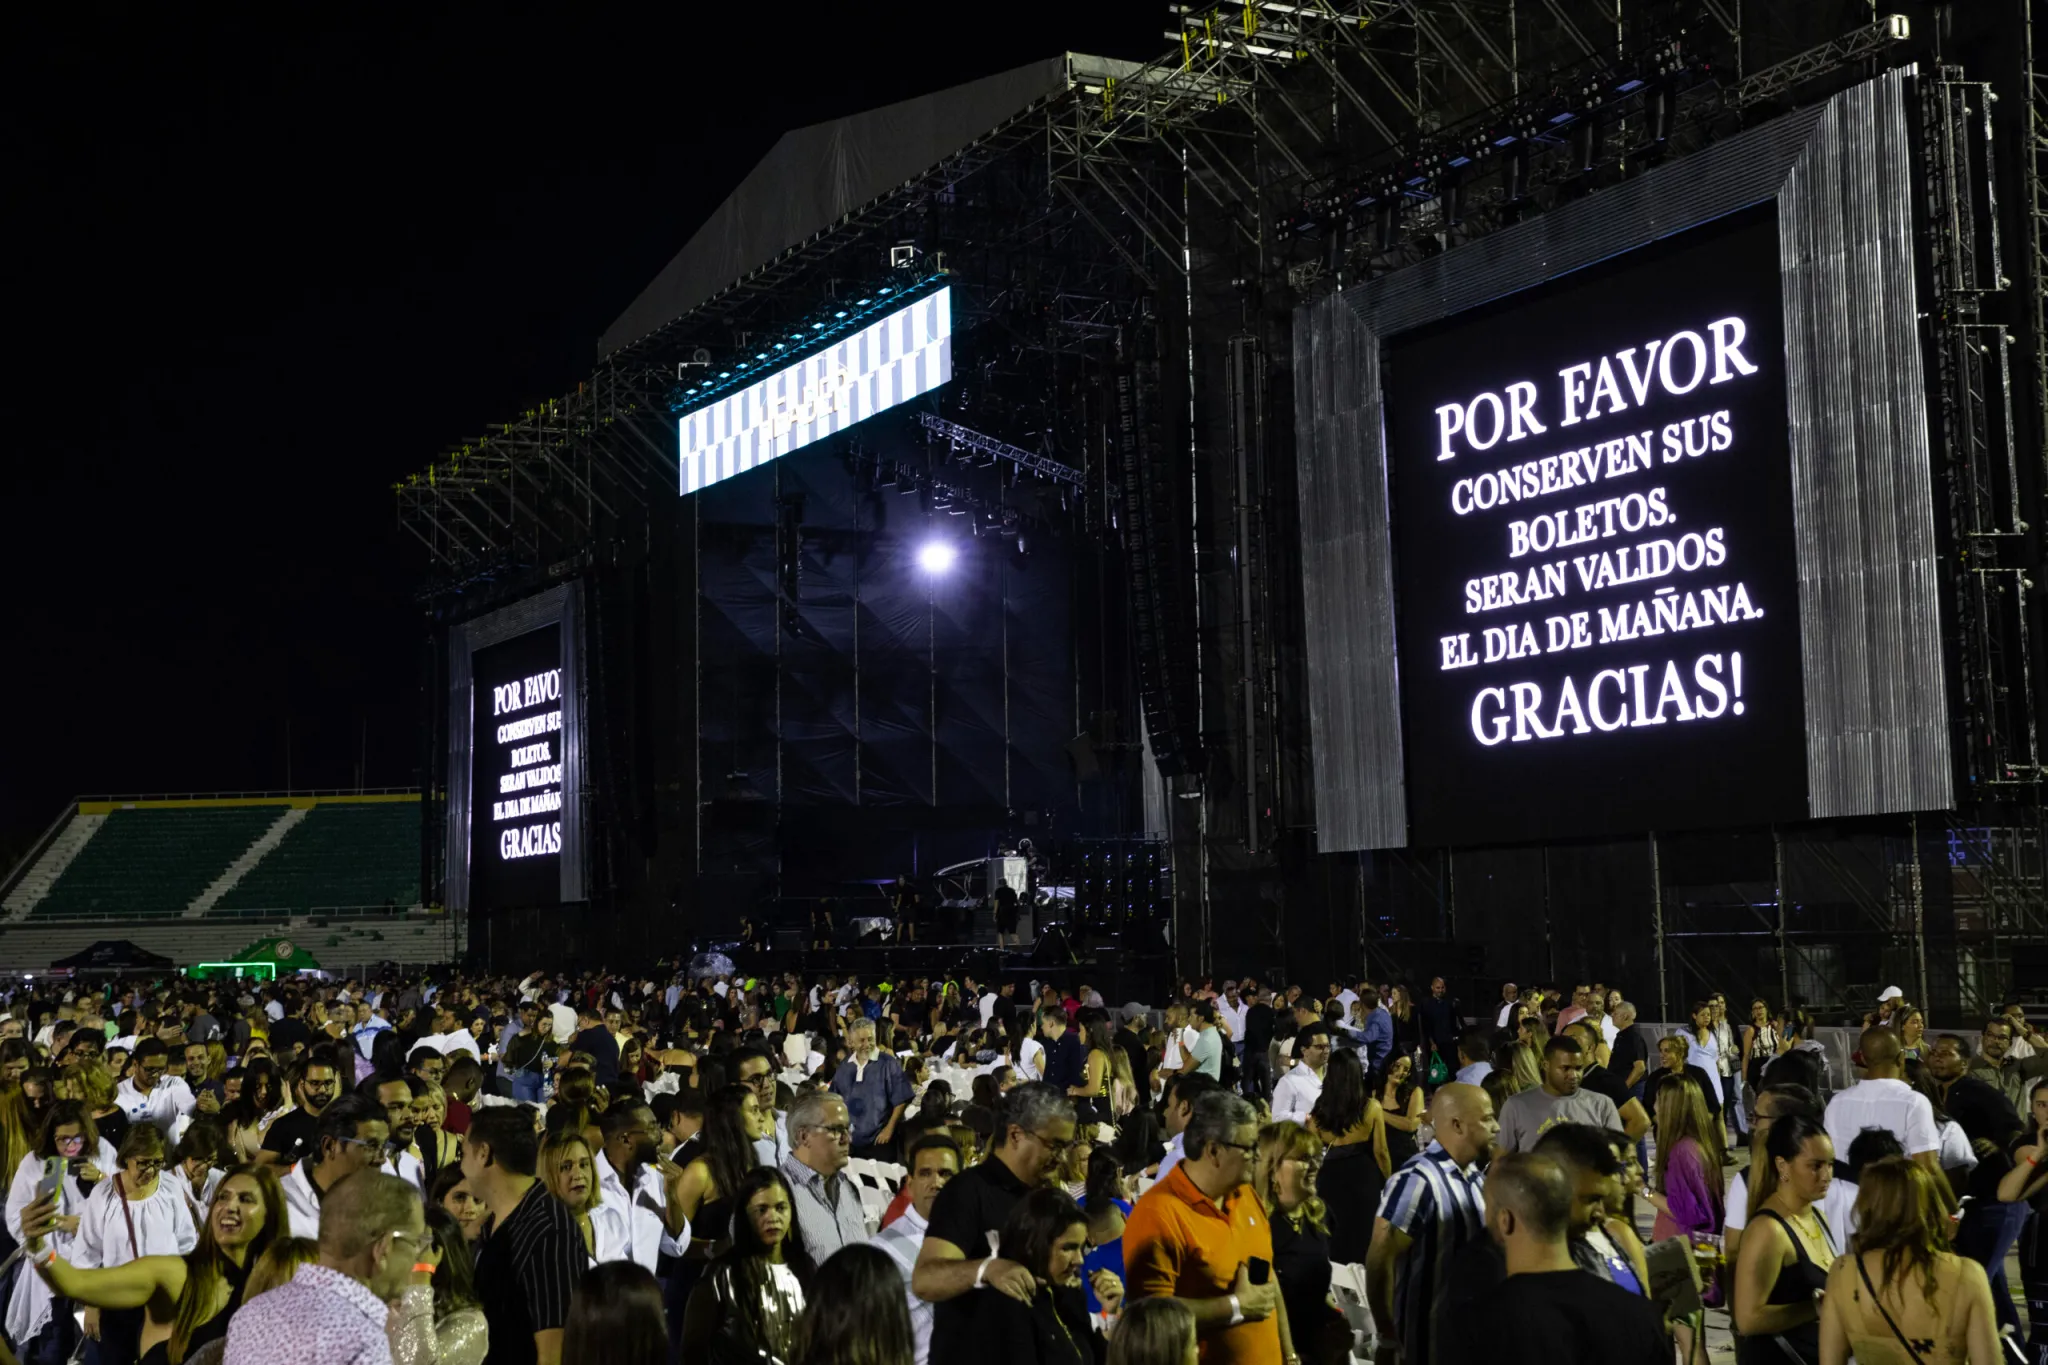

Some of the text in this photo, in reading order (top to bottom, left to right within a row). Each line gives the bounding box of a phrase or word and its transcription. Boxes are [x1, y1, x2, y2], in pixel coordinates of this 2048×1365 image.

[1435, 317, 1758, 461] POR FAVOR
[1452, 410, 1732, 514] CONSERVEN SUS
[1509, 487, 1676, 557] BOLETOS.
[1466, 528, 1726, 613] SERAN VALIDOS
[1440, 585, 1763, 670] EL DIA DE MAÑANA.
[494, 669, 561, 715] POR FAVO
[1472, 652, 1744, 745] GRACIAS!
[494, 802, 505, 820] EL
[504, 800, 521, 818] DIA
[531, 789, 561, 814] MAÑAN
[526, 761, 562, 787] VALIDOS
